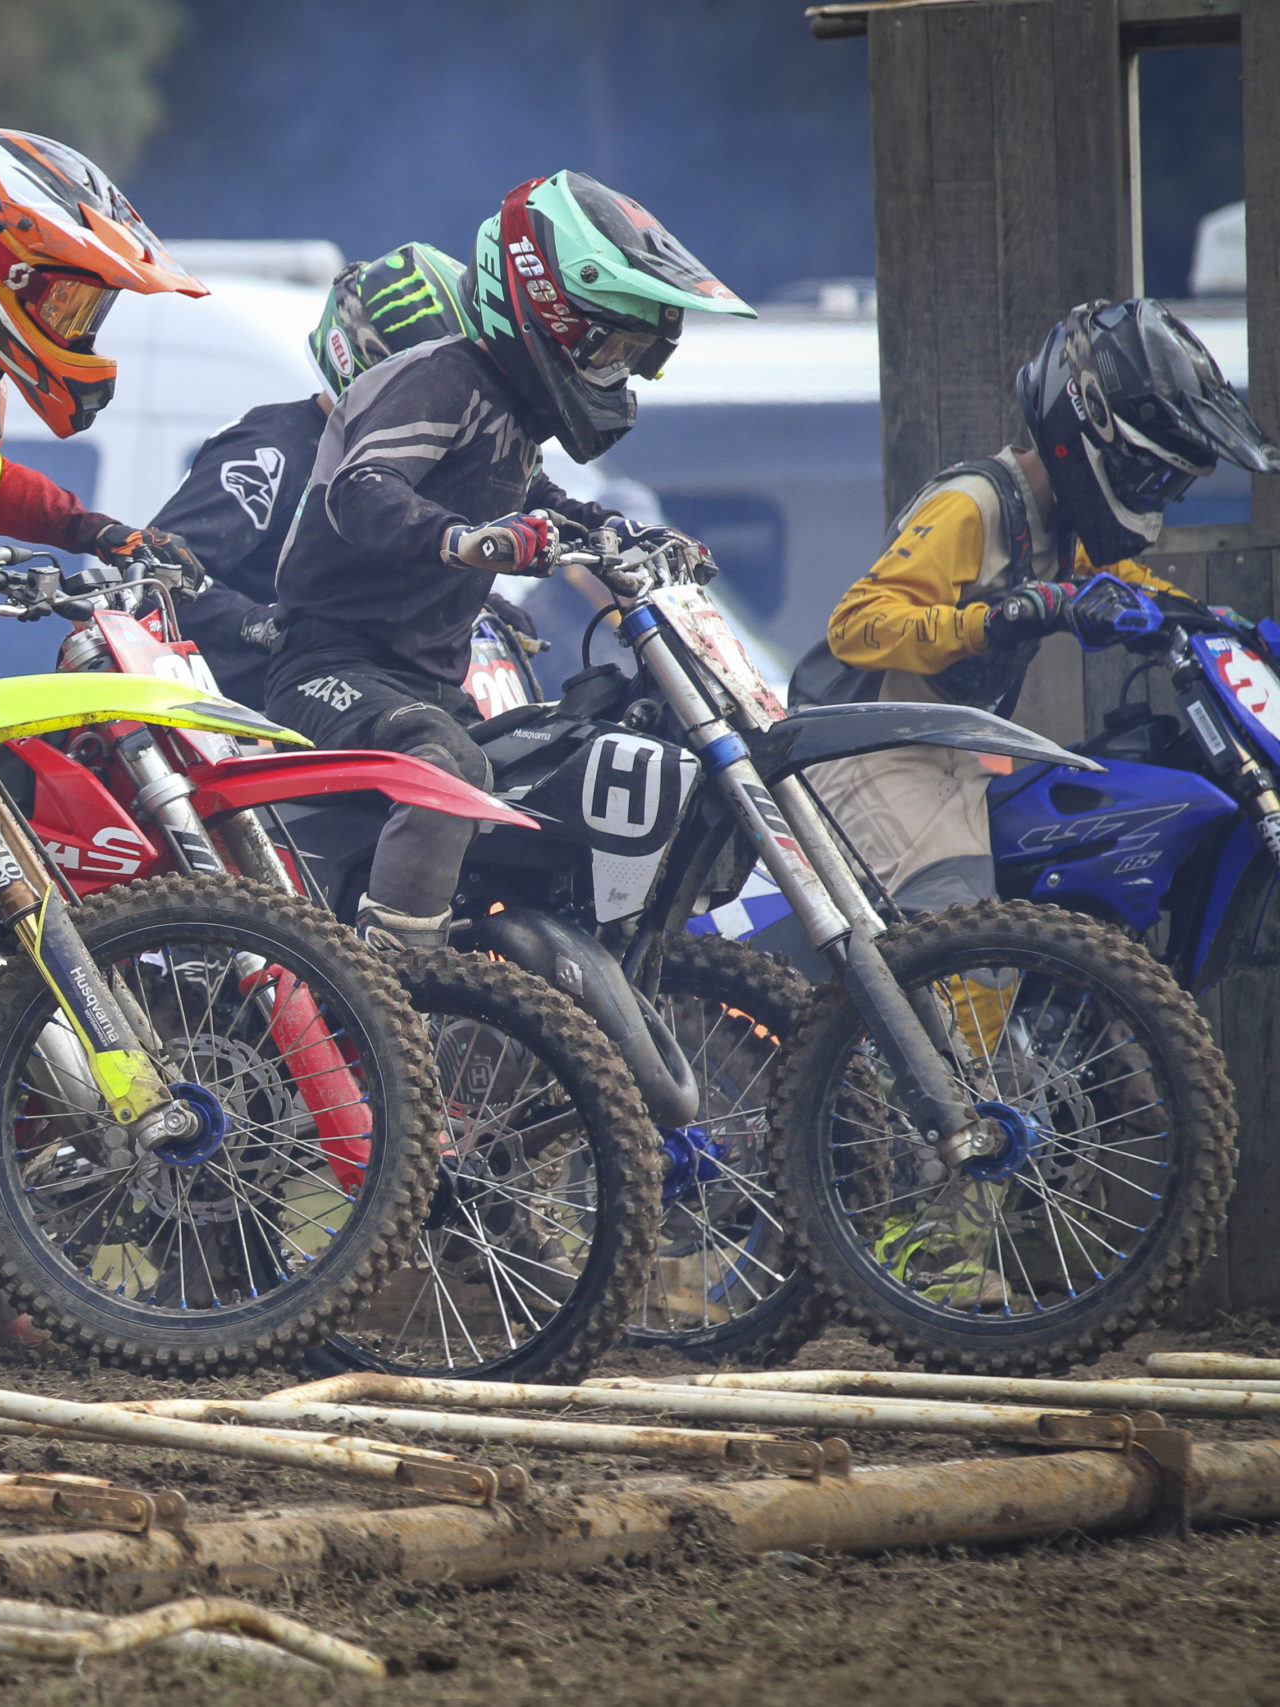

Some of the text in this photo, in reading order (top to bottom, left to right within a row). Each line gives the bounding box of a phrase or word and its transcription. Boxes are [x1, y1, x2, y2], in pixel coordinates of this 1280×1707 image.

[508, 235, 580, 333] 100%
[331, 332, 349, 371] BELL
[70, 966, 121, 1044] Husqvarna
[83, 1008, 110, 1048] MOTORCYCLES
